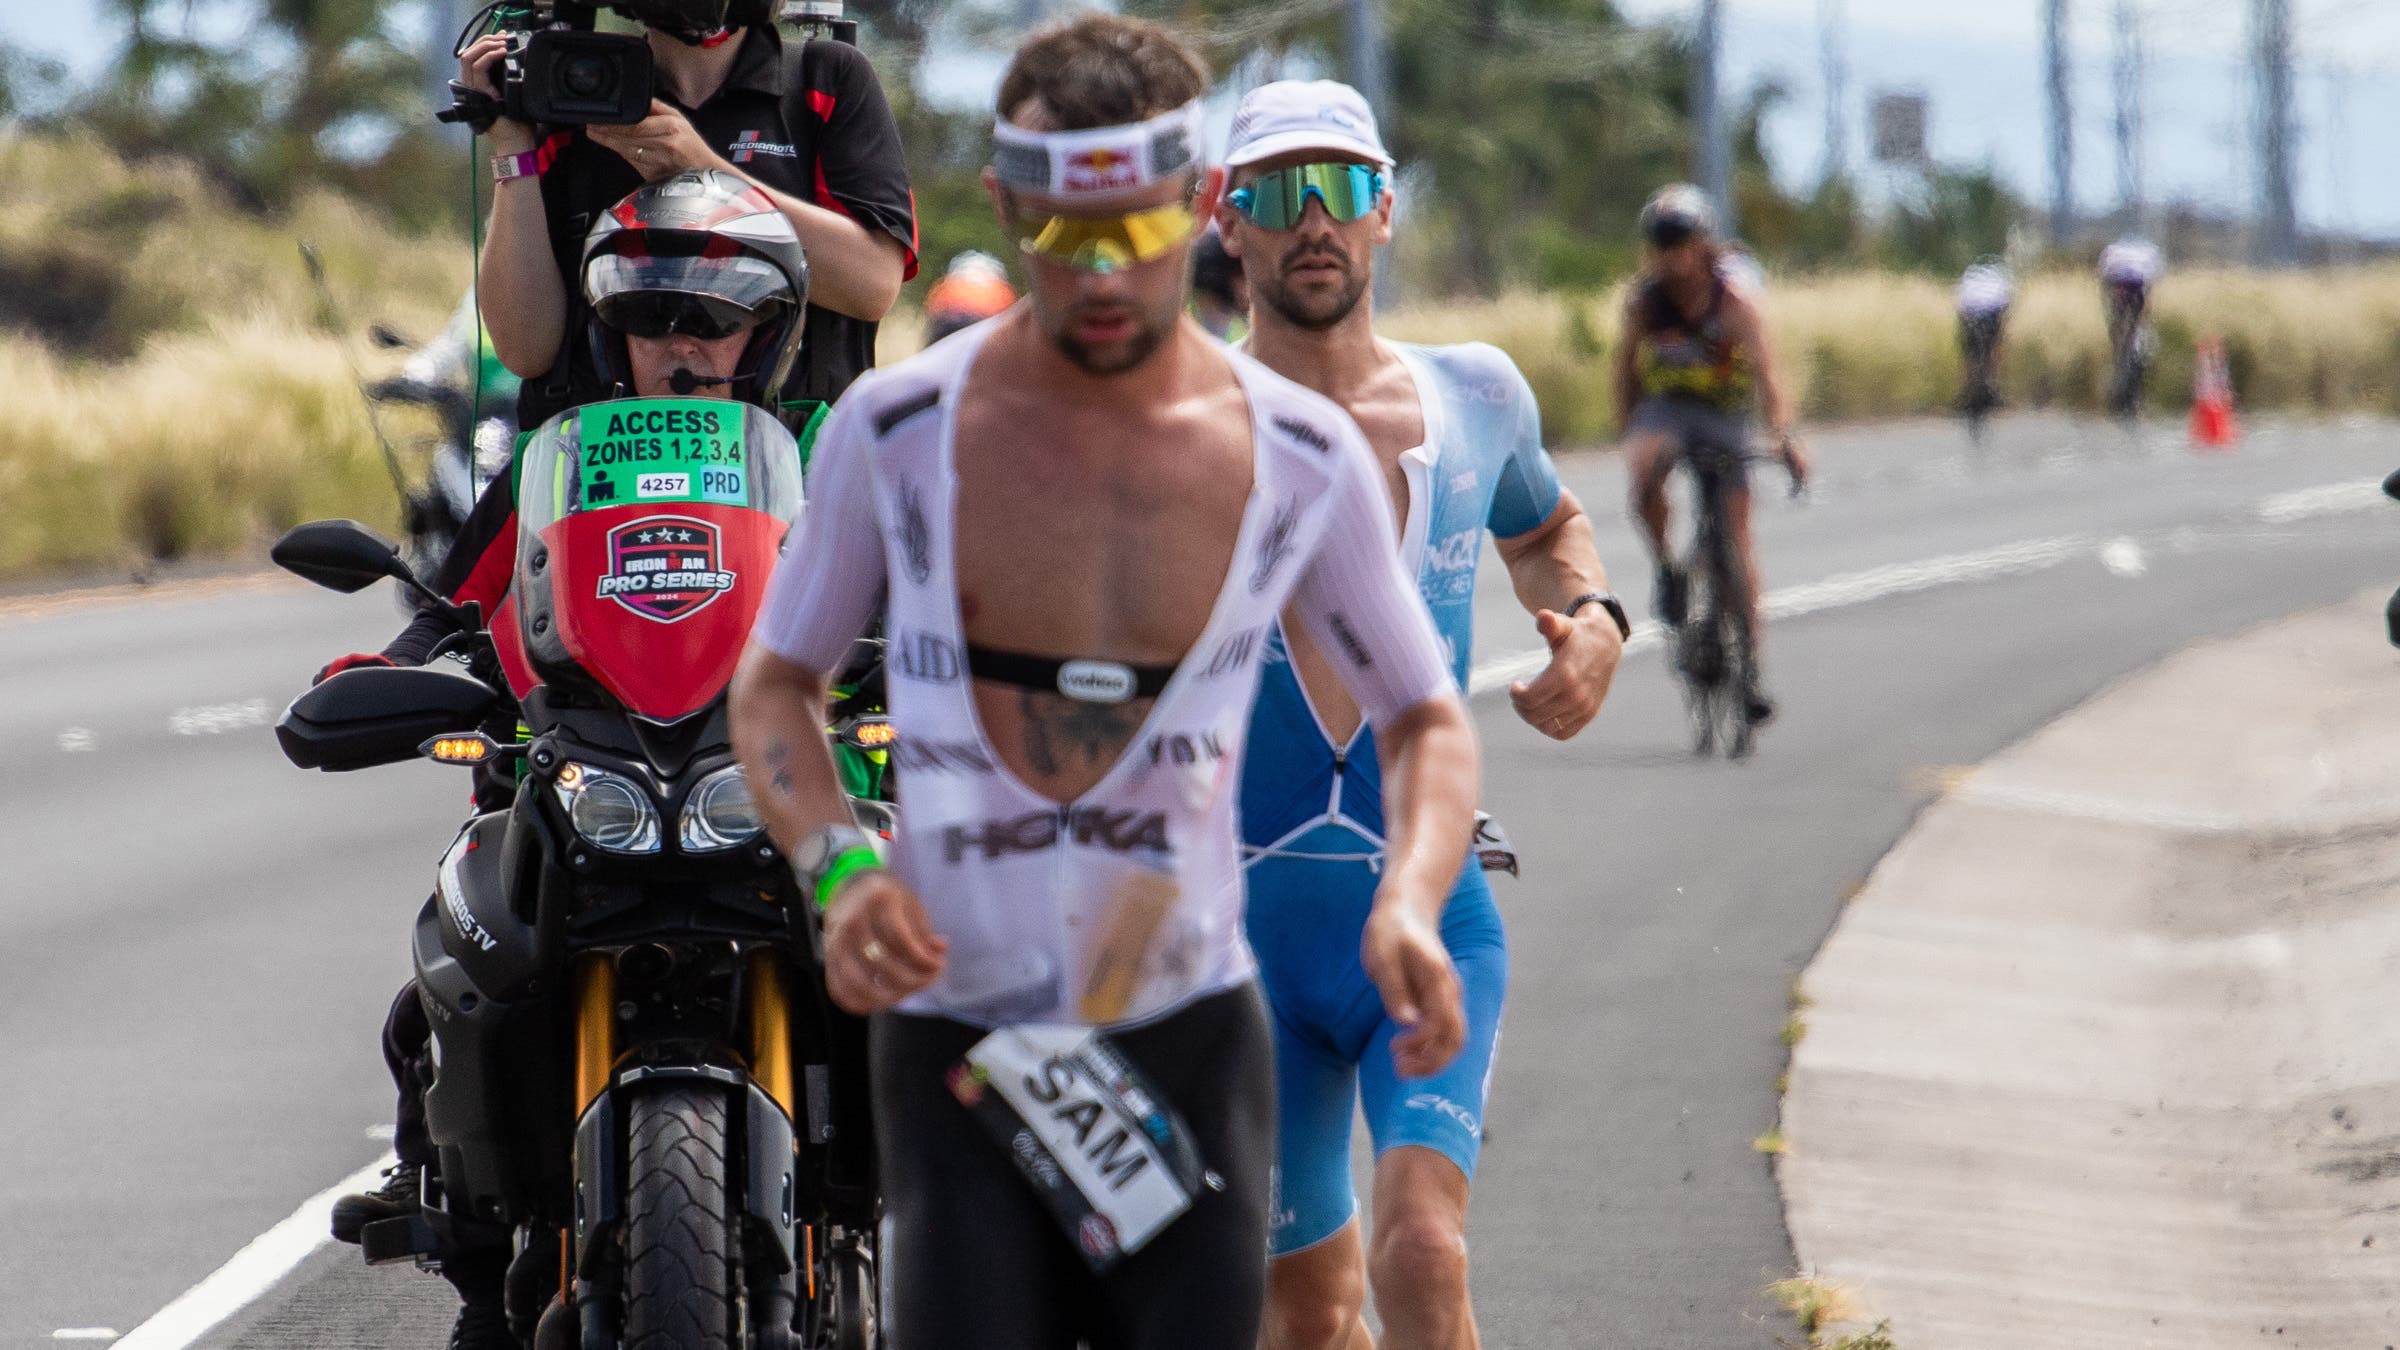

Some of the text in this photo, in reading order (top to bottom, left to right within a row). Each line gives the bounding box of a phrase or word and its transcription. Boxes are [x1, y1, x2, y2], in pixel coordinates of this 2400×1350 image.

[607, 409, 721, 438] ACCESS
[585, 437, 742, 467] ZONES 1,2,3,4
[640, 478, 686, 492] 4257
[702, 470, 741, 495] PRD
[600, 571, 731, 594] PRO SERIES
[1022, 1056, 1149, 1192] SAM
